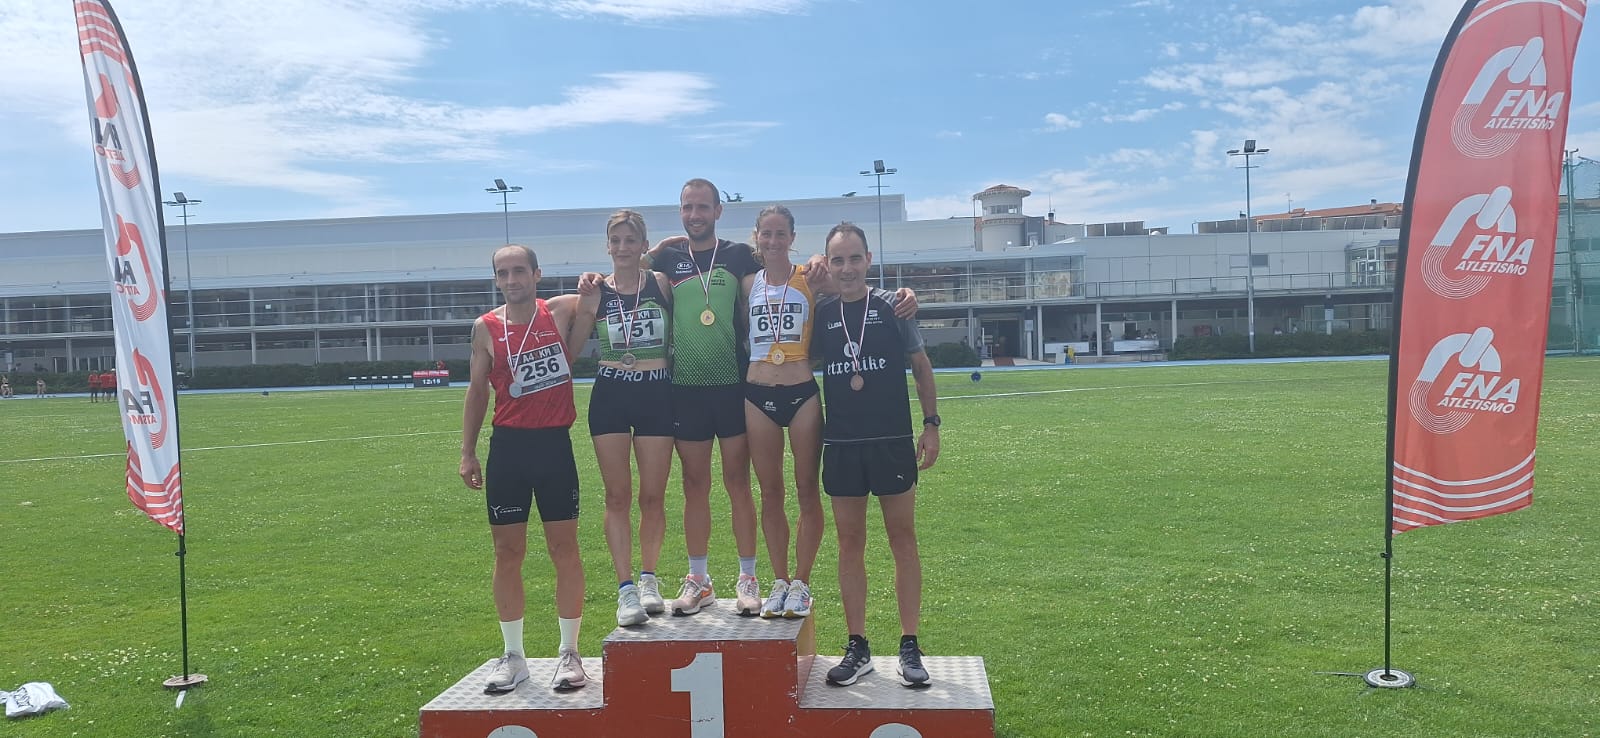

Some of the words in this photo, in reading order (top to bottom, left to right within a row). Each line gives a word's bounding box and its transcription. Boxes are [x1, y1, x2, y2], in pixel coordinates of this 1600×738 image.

[1491, 89, 1565, 119] FNA
[1484, 118, 1555, 130] ATLETISMO
[1462, 234, 1535, 265] FNA
[1455, 260, 1527, 276] ATLETISMO
[521, 357, 560, 381] 256
[613, 369, 644, 382] PRO
[1444, 372, 1520, 404] FNA
[1437, 397, 1515, 413] ATLETISMO
[670, 652, 724, 738] 1
